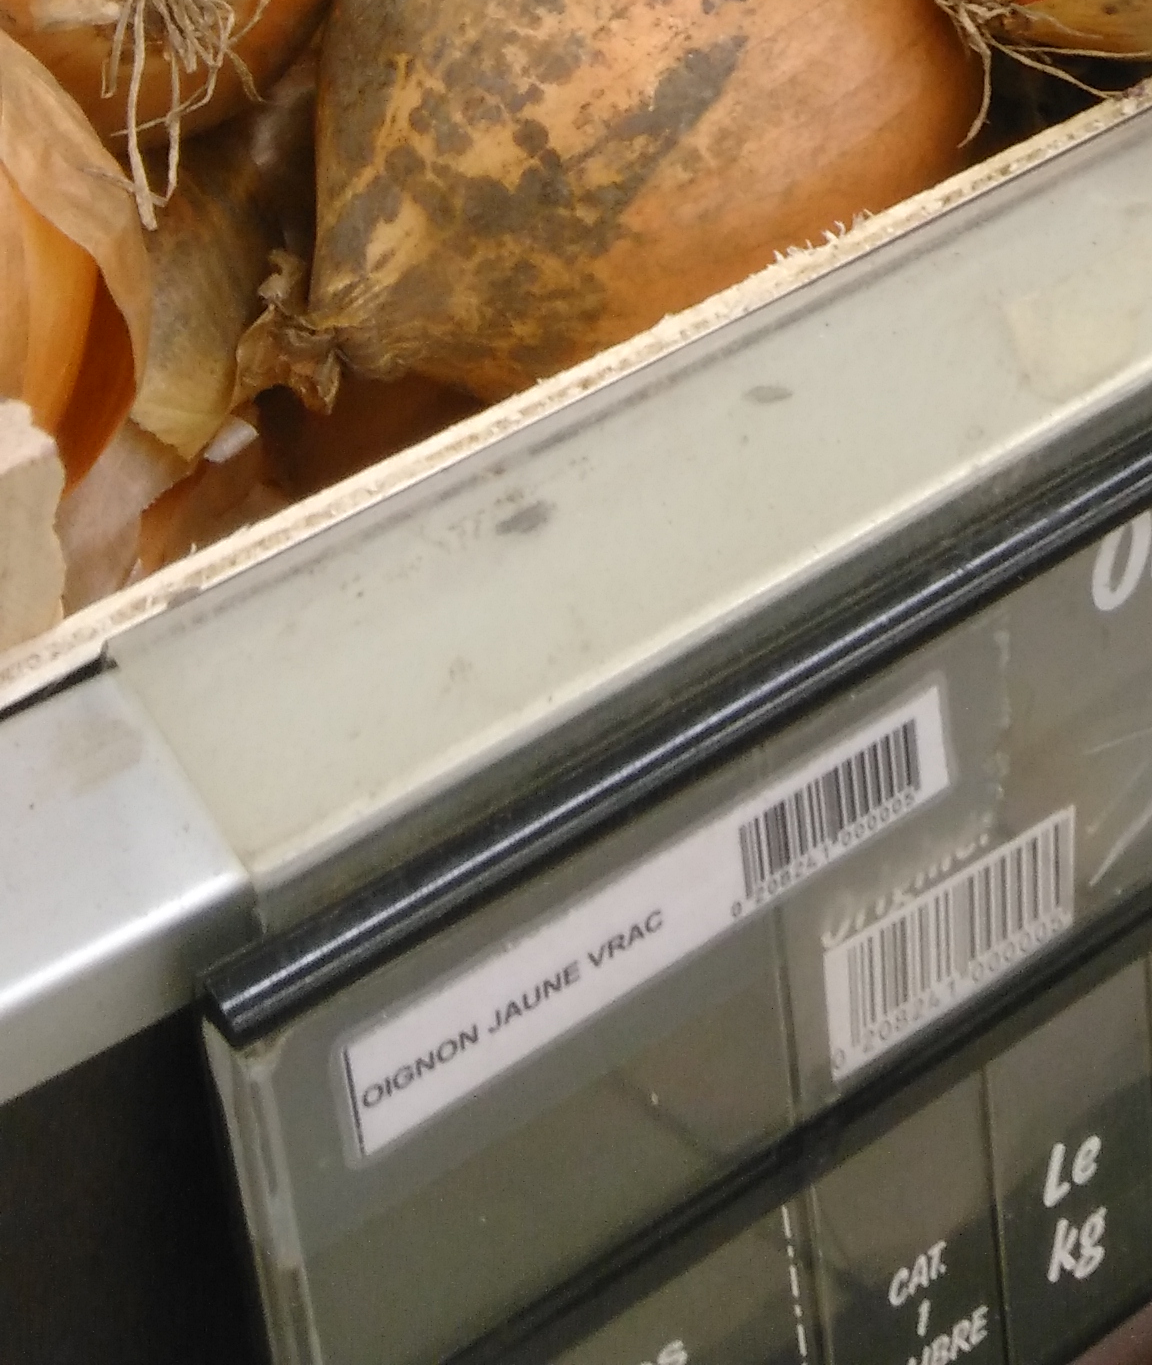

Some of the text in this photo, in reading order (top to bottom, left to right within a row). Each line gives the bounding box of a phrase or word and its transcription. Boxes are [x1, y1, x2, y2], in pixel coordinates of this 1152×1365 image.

[361, 907, 664, 1109] OIGNON JAUNE VRAC
[1042, 1133, 1102, 1208] Le
[888, 1239, 948, 1306] CAT.
[906, 1304, 989, 1365] IBRE
